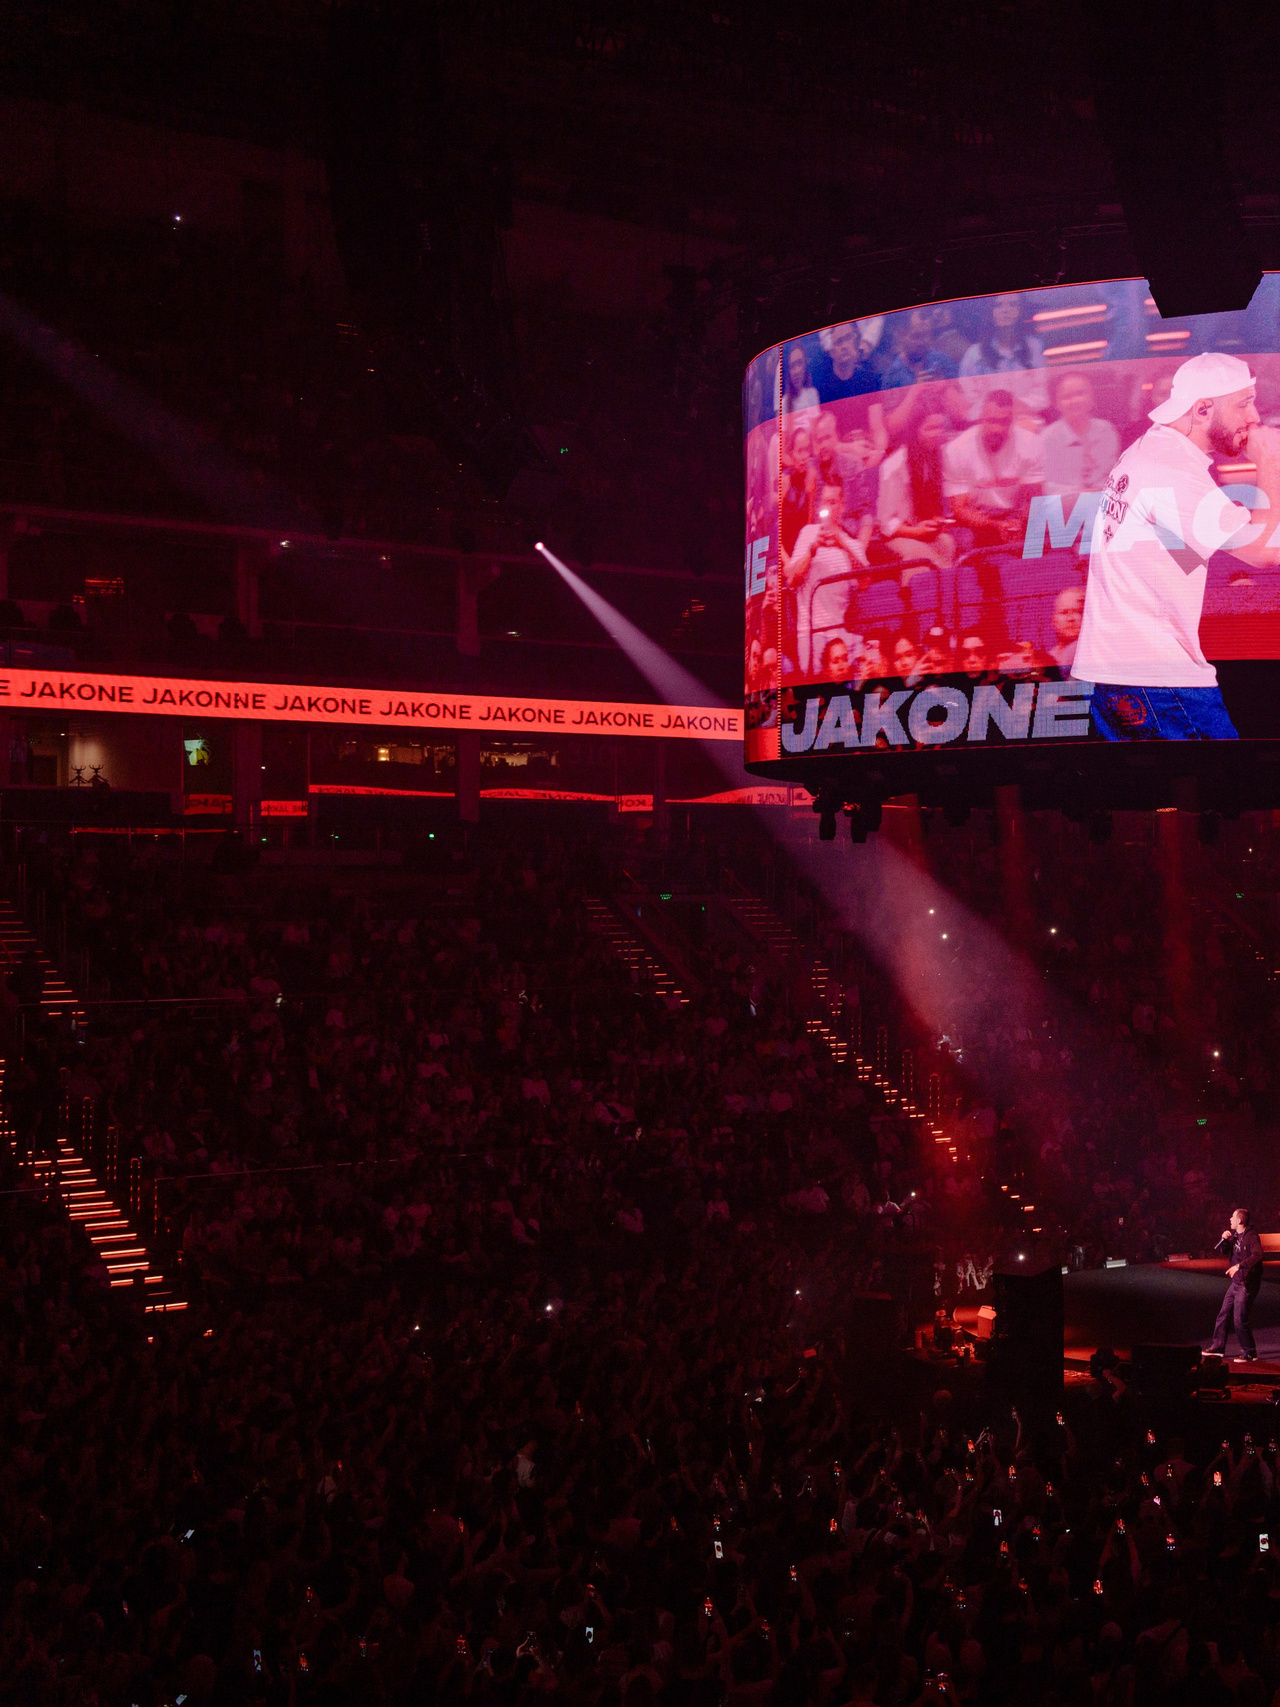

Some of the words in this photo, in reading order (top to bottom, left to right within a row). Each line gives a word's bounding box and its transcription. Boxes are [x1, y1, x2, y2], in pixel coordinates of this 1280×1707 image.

[20, 681, 134, 703] JAKONE
[274, 695, 372, 715] JAKONE
[380, 701, 472, 720] JAKONE
[478, 706, 566, 724] JAKONE
[571, 710, 654, 728] JAKONE
[660, 714, 738, 732] JAKONE
[781, 680, 1095, 753] JAKONE
